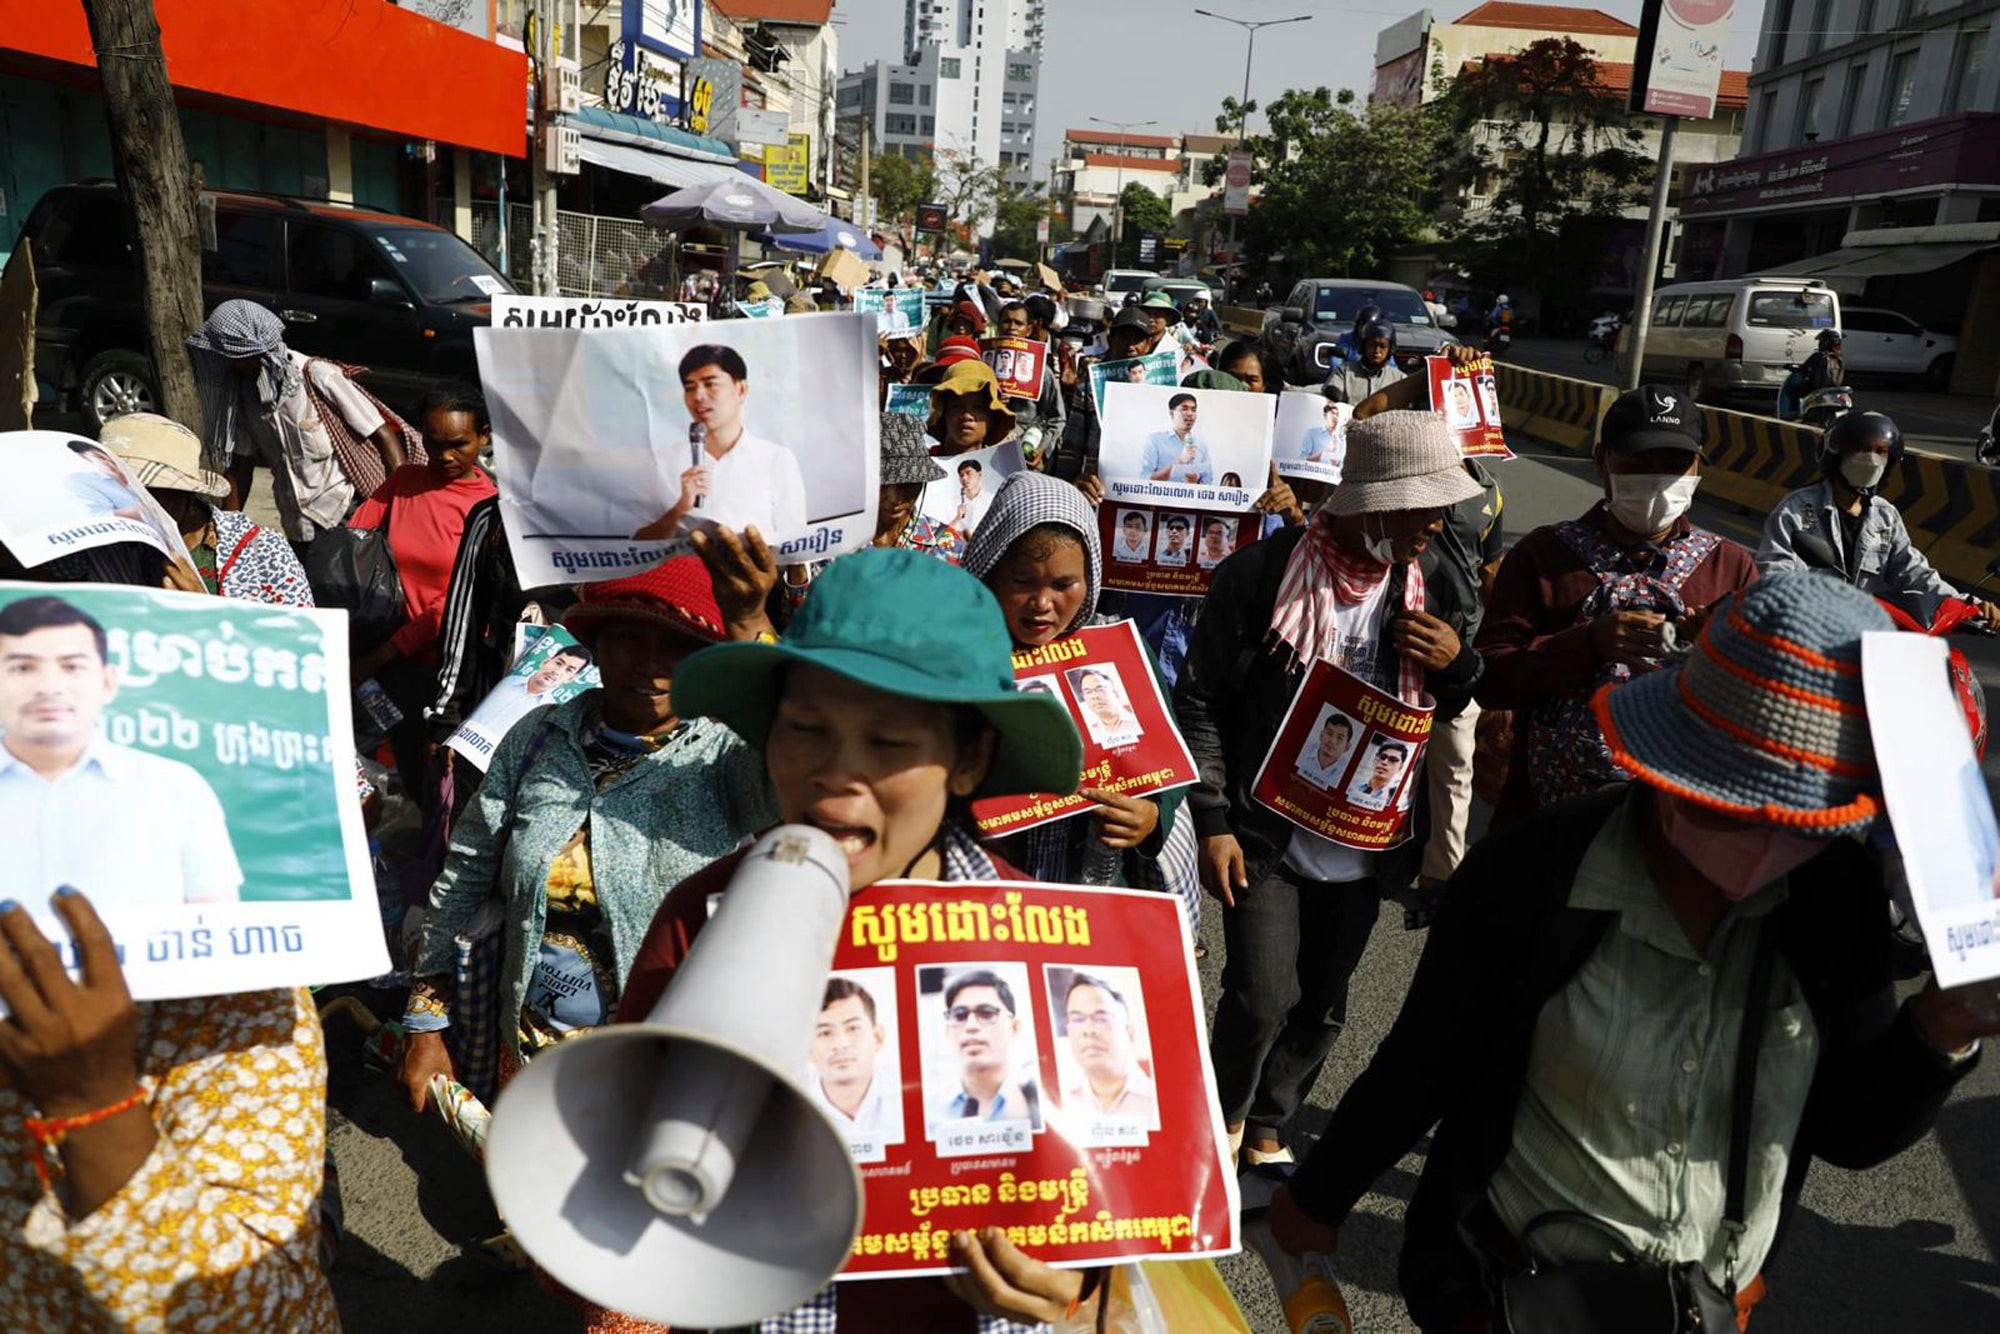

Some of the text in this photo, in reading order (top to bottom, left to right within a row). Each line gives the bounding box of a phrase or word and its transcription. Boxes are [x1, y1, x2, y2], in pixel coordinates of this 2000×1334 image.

[1649, 415, 1681, 426] LANNO
[851, 892, 1092, 961] សូមដោះលែង
[543, 974, 579, 998] LOUIS
[908, 1182, 991, 1217] ប្រធាន
